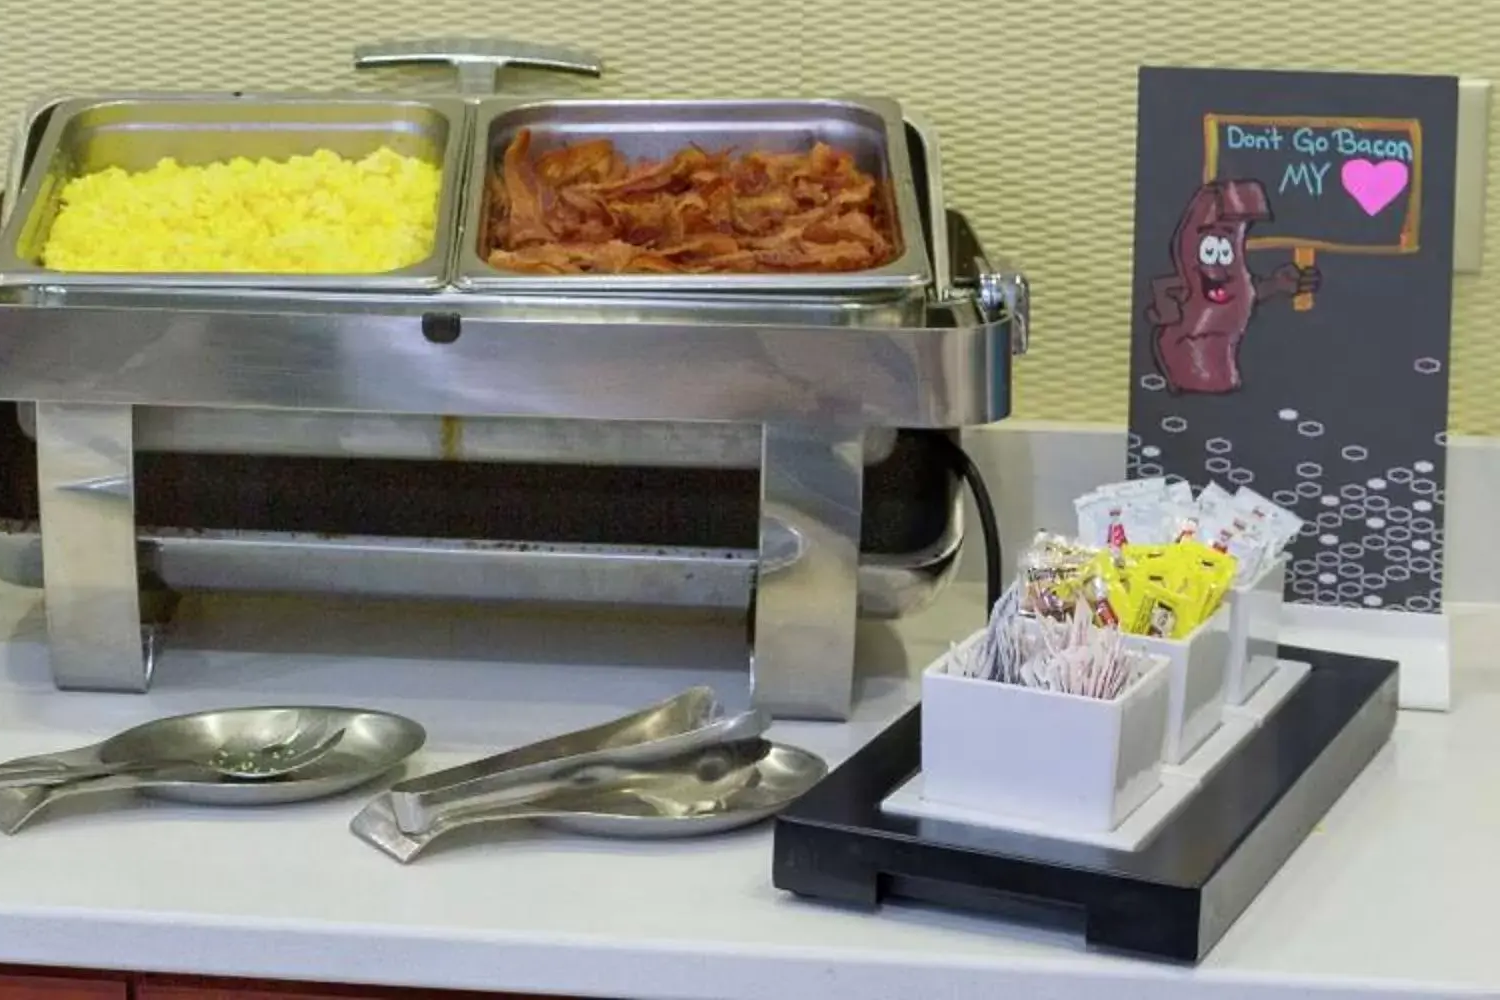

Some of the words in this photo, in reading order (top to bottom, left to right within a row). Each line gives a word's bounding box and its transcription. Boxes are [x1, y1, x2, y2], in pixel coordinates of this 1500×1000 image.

[1227, 125, 1283, 149] Don't
[1293, 127, 1329, 155] Go
[1331, 128, 1413, 160] Bacon
[1278, 161, 1331, 195] MY
